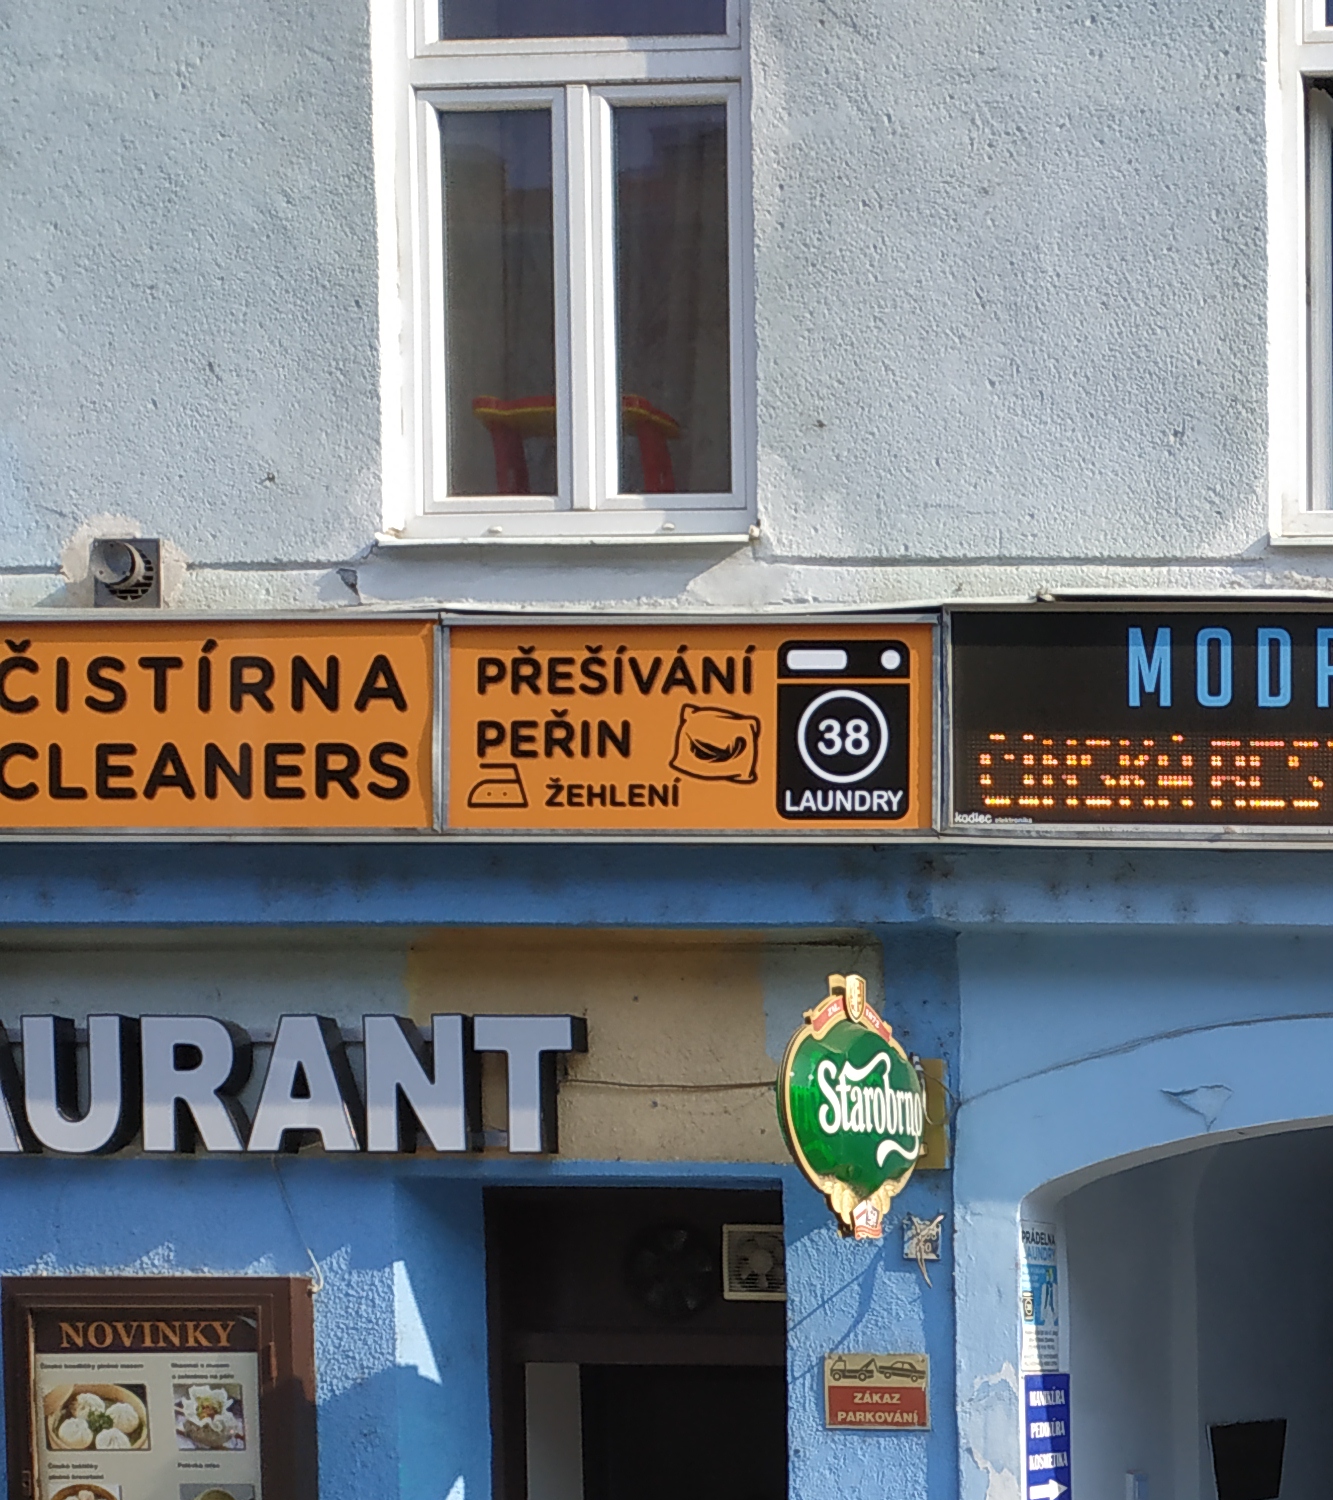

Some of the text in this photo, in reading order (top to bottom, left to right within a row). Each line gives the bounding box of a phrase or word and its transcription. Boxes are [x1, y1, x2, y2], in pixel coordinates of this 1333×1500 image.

[0, 638, 408, 714] ČISTÍRNA
[477, 645, 754, 696] PŘEŠÍVÁNÍ
[477, 711, 632, 759] PEŘIN
[816, 718, 865, 757] 38
[0, 742, 410, 801] CLEANERS
[544, 776, 682, 808] ŽEHLENÍ
[785, 790, 903, 813] LAUNDRY
[0, 1013, 573, 1153] URANT
[817, 1052, 923, 1167] Starobrno
[60, 1321, 235, 1348] NOVINKY
[837, 1408, 918, 1424] PARKOVÁNÍ
[853, 1391, 901, 1404] ZÁKAZ
